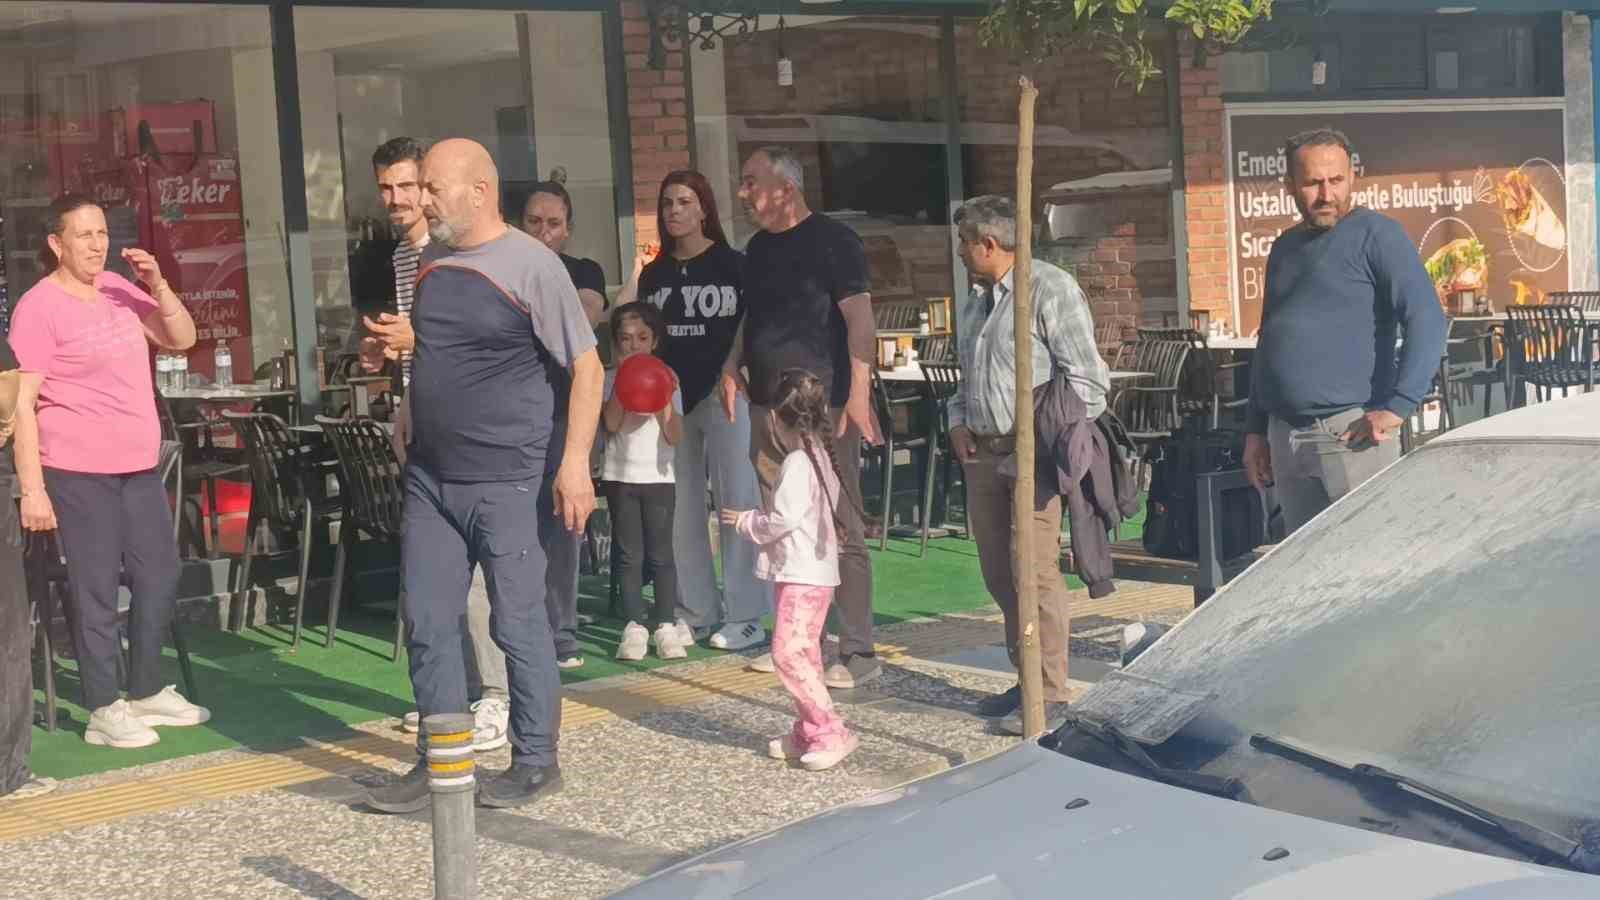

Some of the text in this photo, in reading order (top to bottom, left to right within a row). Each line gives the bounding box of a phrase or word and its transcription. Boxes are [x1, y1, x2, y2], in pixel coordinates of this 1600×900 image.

[1238, 148, 1288, 182] Emeğ
[1392, 180, 1473, 213] Buluştuğu
[681, 284, 744, 318] YOR
